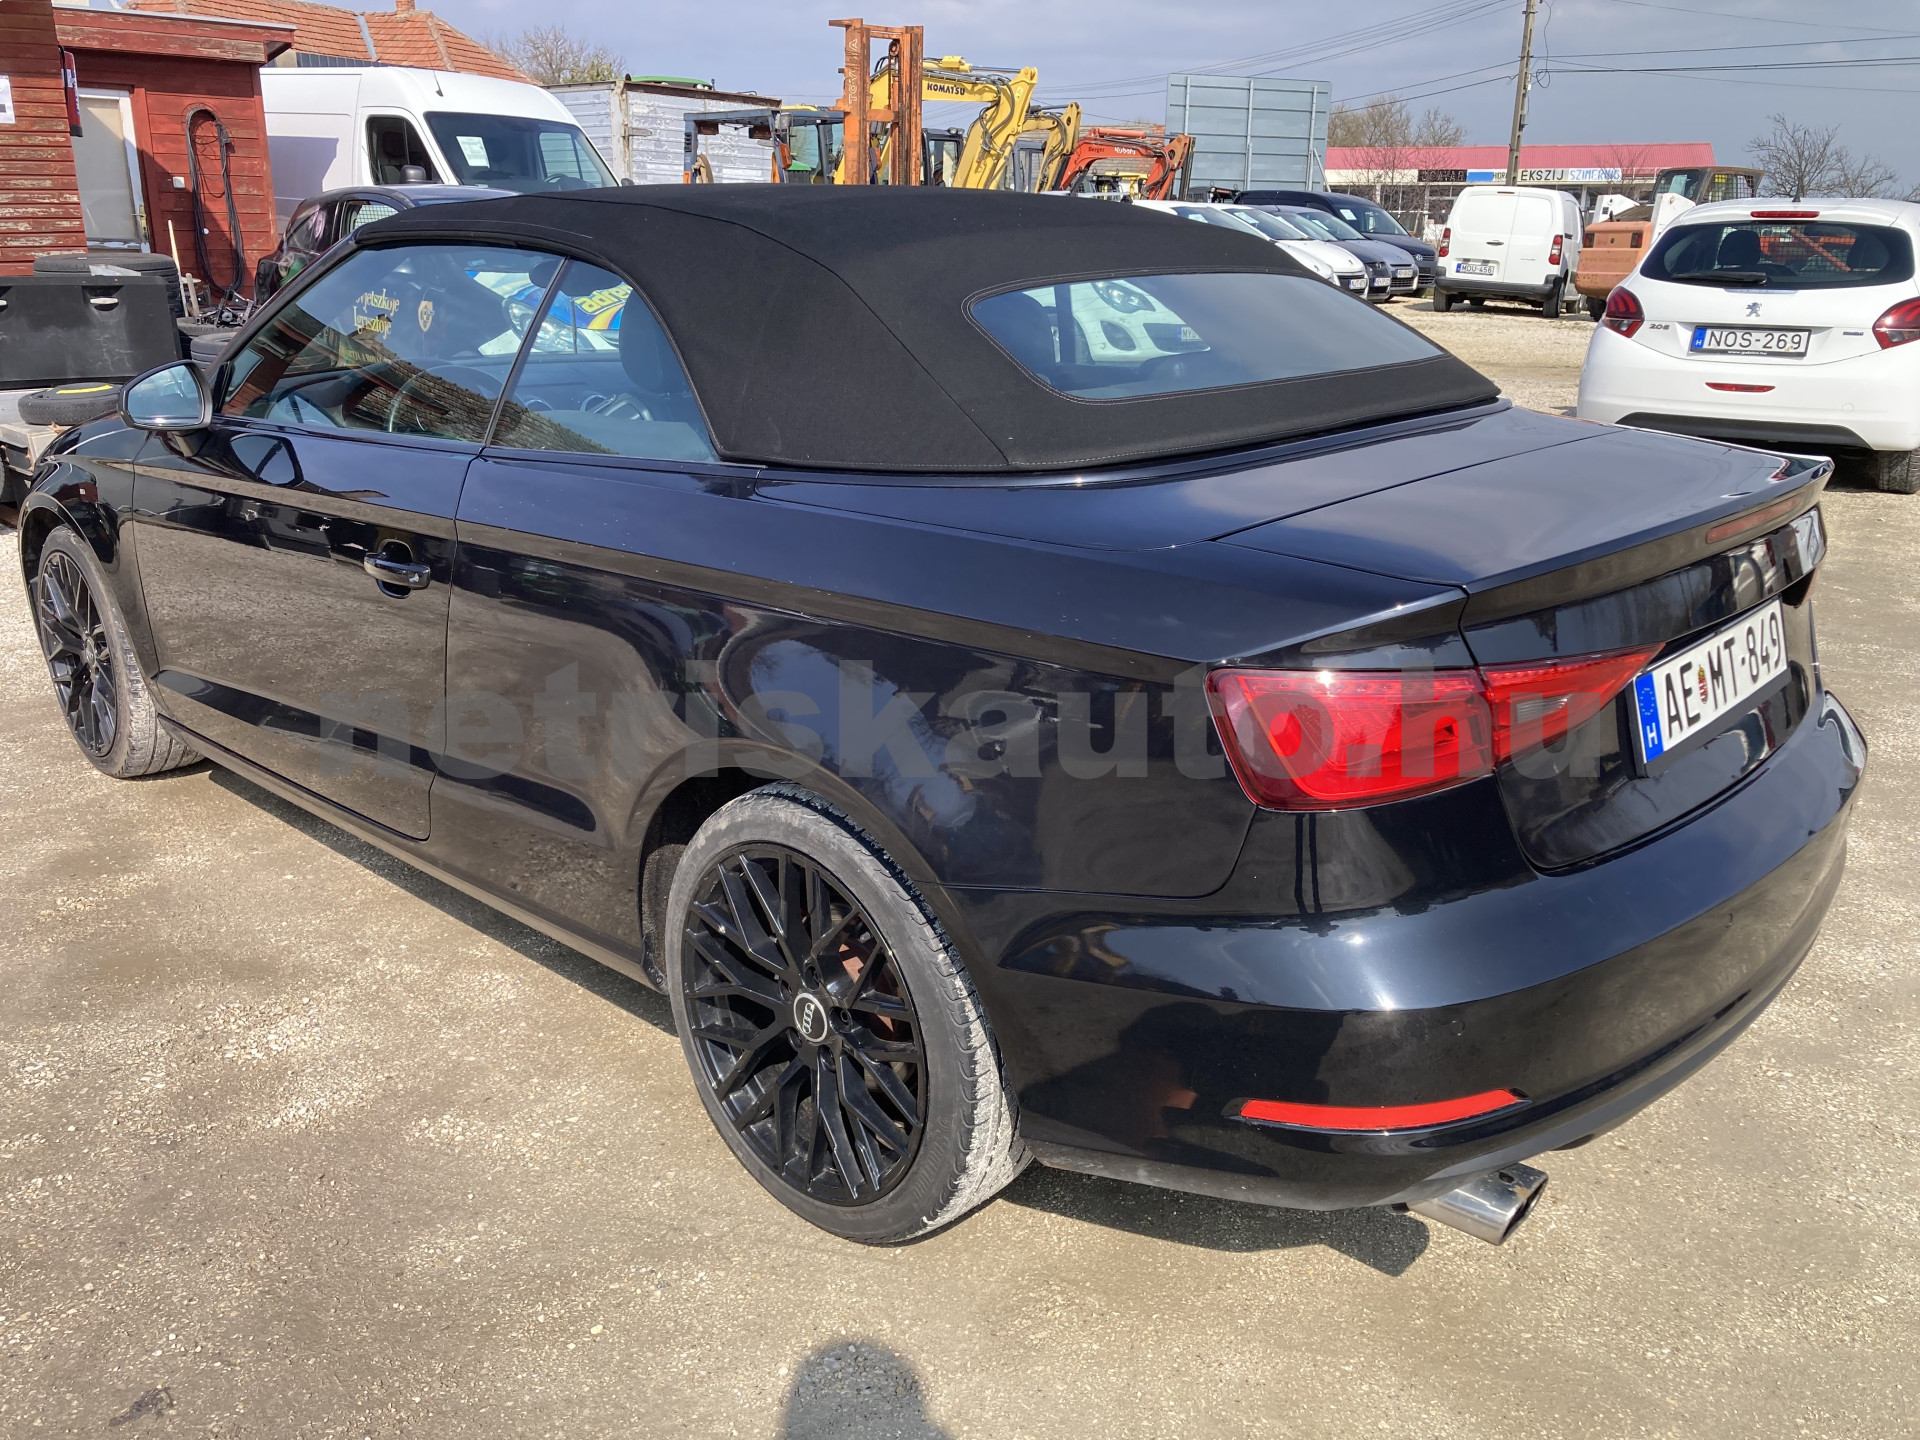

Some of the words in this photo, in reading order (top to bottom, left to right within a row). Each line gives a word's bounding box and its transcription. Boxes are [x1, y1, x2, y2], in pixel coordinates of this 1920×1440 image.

[848, 38, 858, 104] TOYA
[926, 82, 966, 96] KOMATSU
[1114, 146, 1136, 155] Kubota
[1707, 330, 1803, 350] NOS-269
[1646, 722, 1659, 748] H
[1664, 661, 1700, 740] AE
[1707, 610, 1781, 710] MT-849
